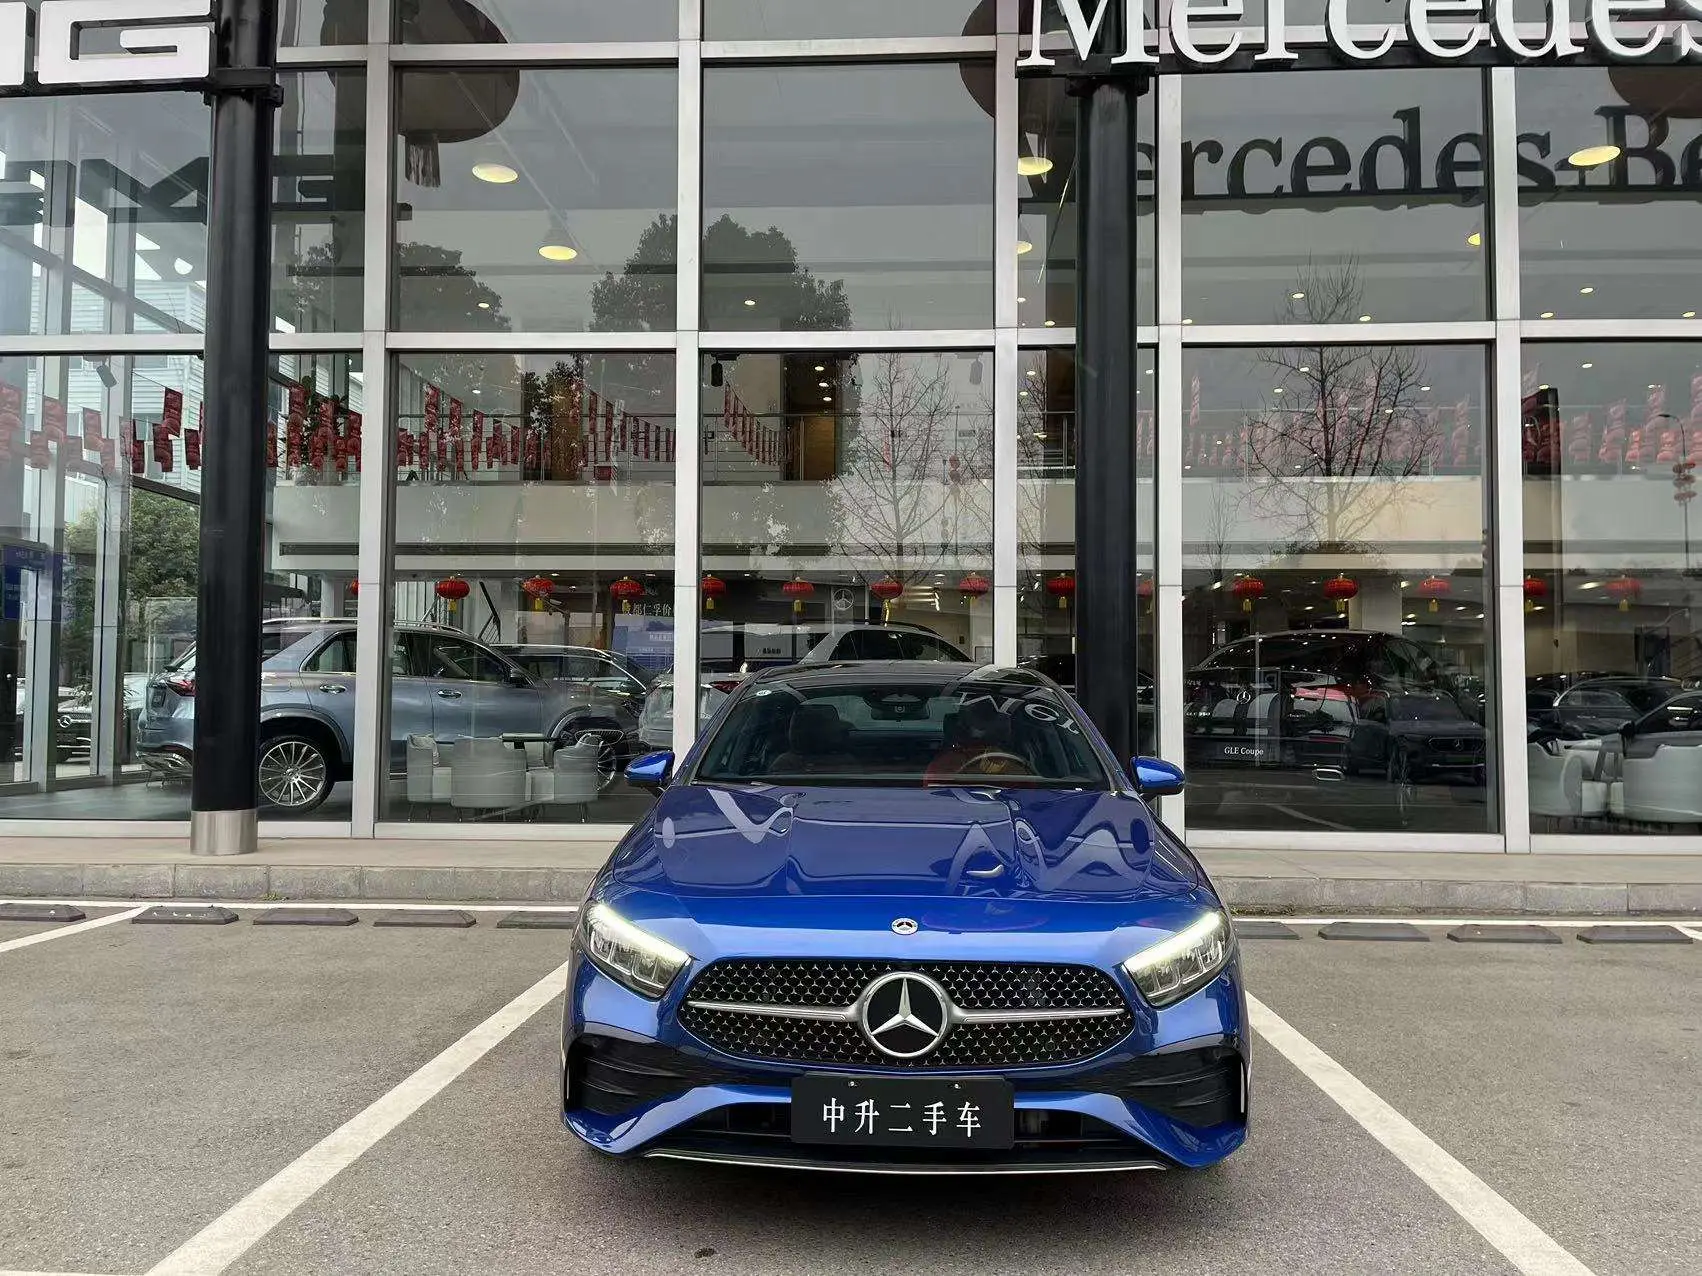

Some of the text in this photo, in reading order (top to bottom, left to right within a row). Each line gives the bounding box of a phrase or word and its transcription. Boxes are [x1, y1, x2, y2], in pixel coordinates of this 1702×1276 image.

[1016, 0, 1702, 67] Mercede
[1224, 747, 1264, 757] GLE Coupe
[823, 1097, 982, 1138] 中升二手车
